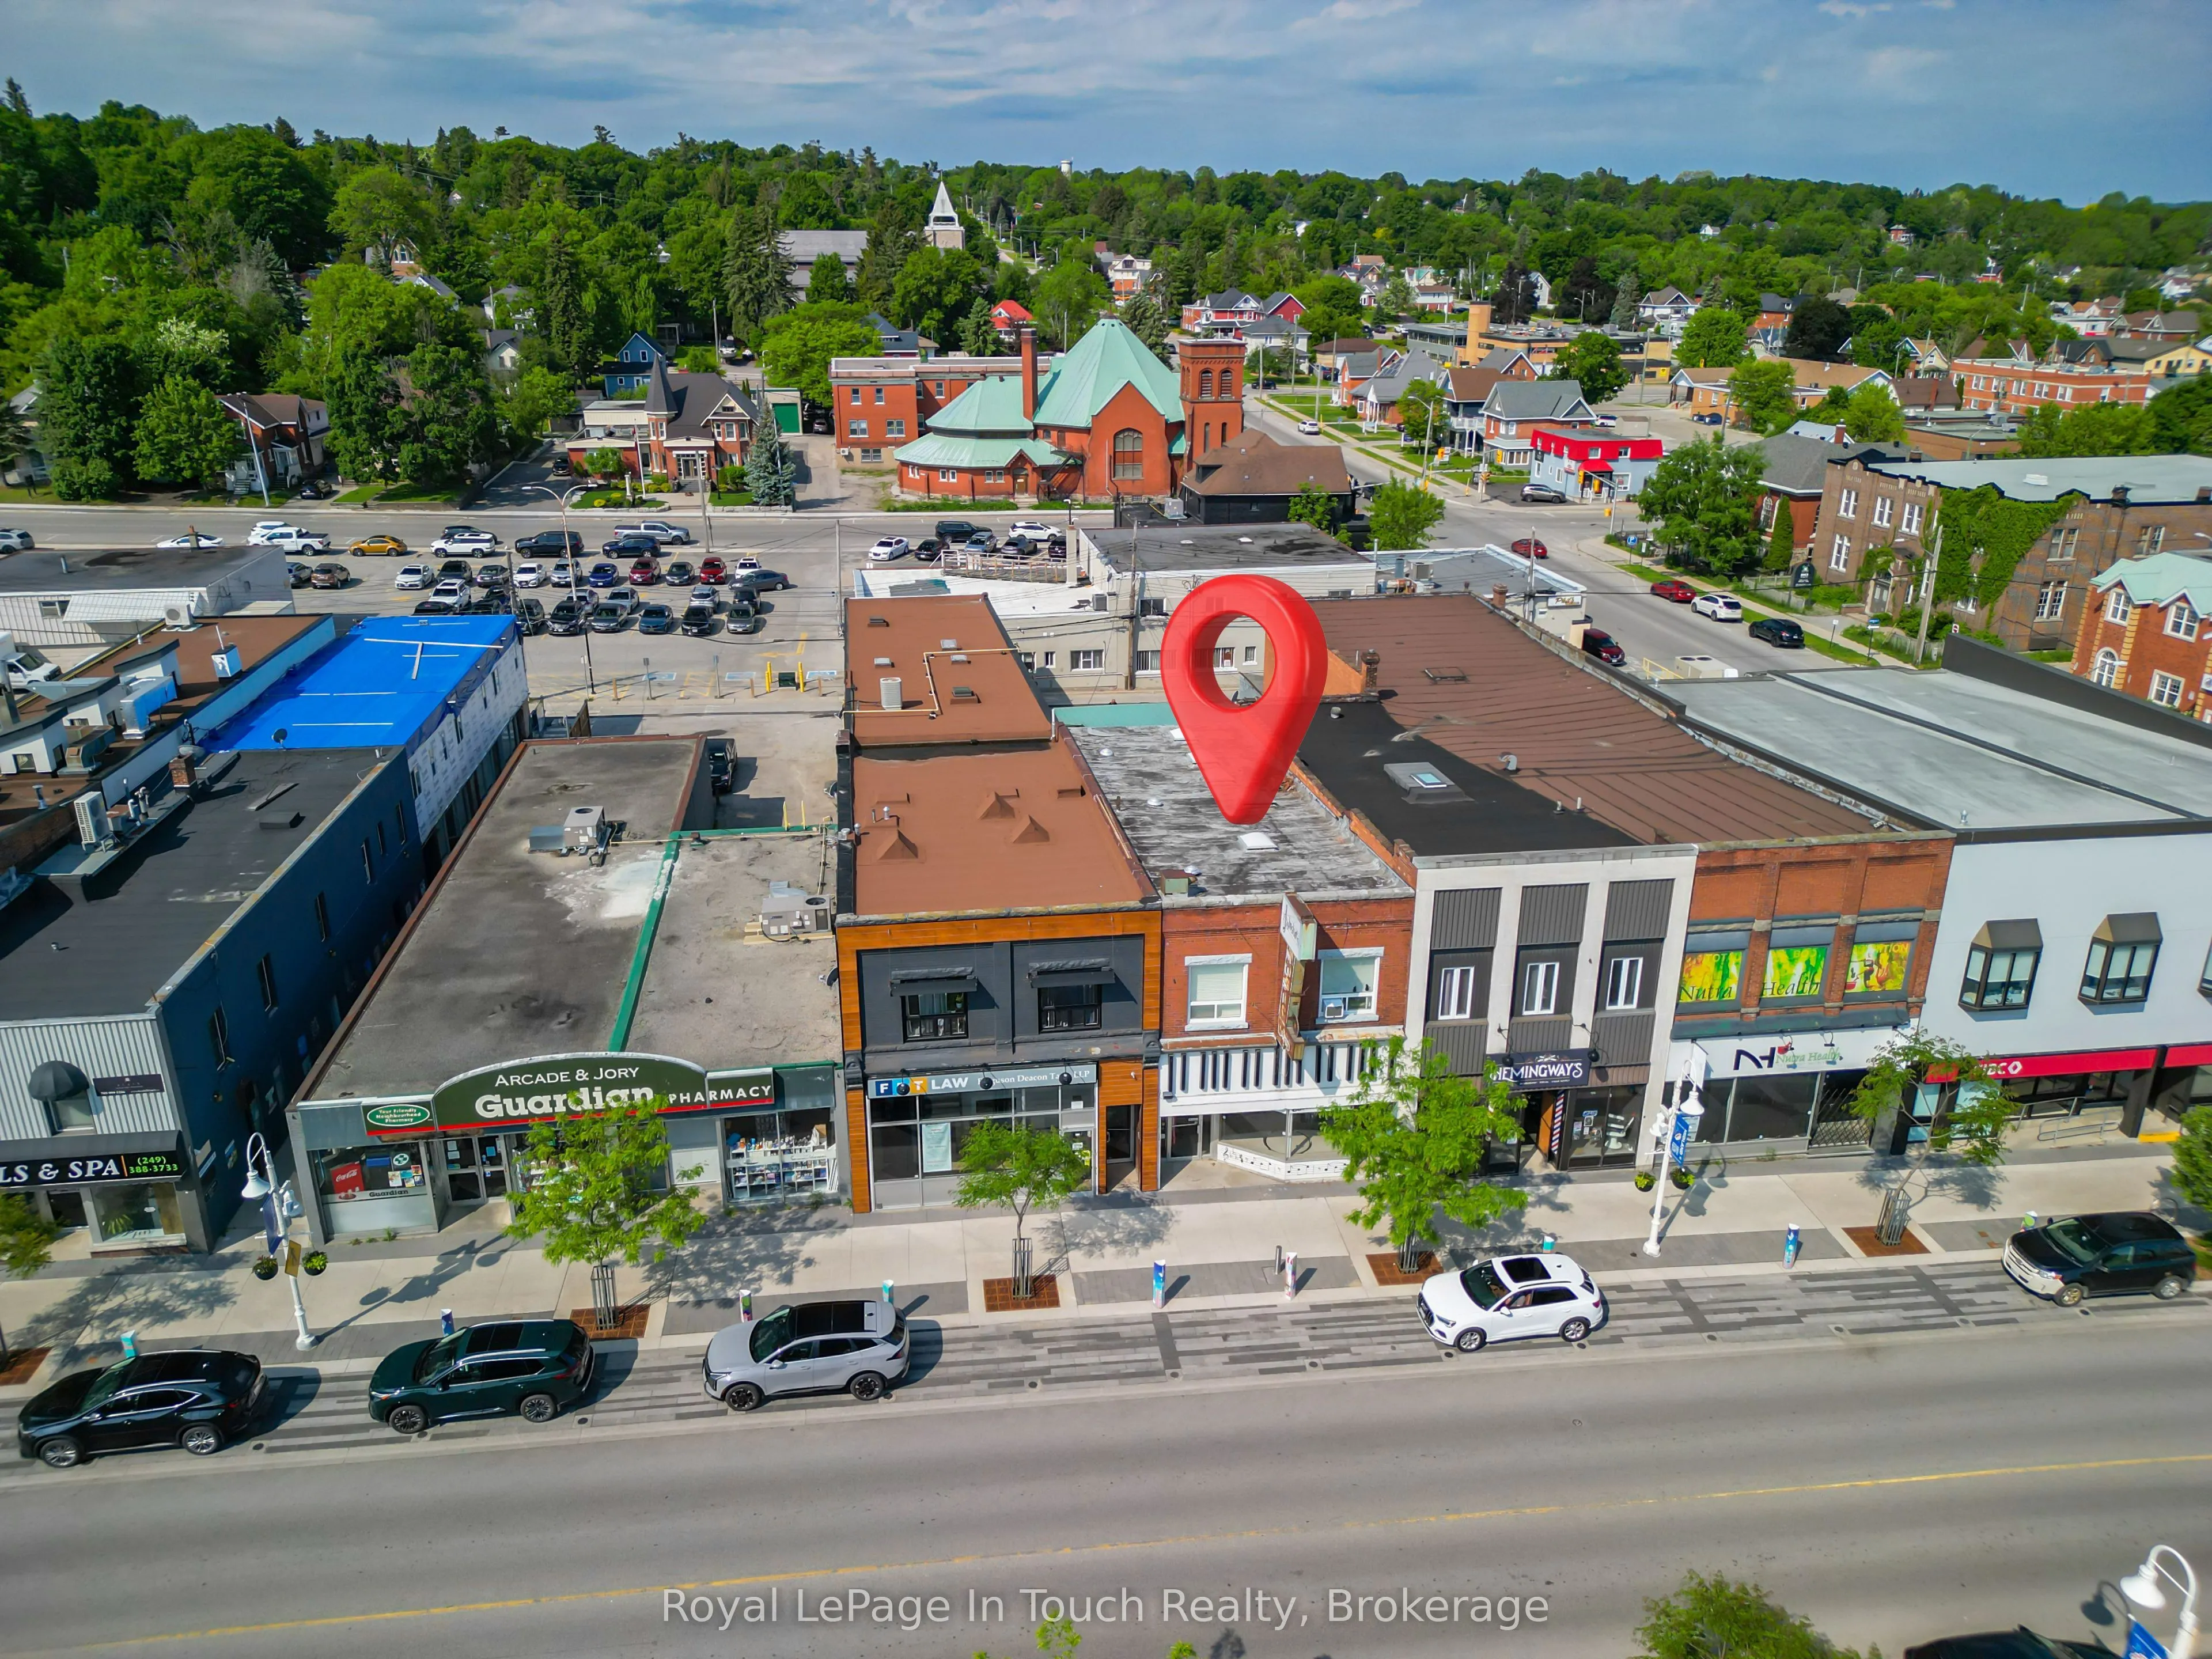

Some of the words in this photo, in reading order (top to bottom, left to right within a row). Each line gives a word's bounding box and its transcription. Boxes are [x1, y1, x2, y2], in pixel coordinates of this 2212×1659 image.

[1680, 985, 1732, 1001] Nutra
[1762, 971, 1820, 996] Health
[1775, 1054, 1806, 1063] Nutra
[1808, 1047, 1840, 1061] Health
[495, 1071, 571, 1087] ARCADE
[575, 1069, 589, 1081] &
[594, 1067, 640, 1081] JORY
[880, 1081, 923, 1094] FT
[931, 1077, 968, 1090] LAW
[978, 1076, 1015, 1086] Fguson
[1017, 1074, 1047, 1082] Deacon
[1074, 1070, 1090, 1079] LLP
[1490, 1062, 1583, 1082] HEMINGWAY'S
[475, 1086, 654, 1118] Guardian
[668, 1085, 771, 1104] PHARMACY
[37, 1163, 59, 1180] &
[68, 1158, 120, 1179] SPA
[137, 1156, 166, 1165] (249)
[369, 1189, 408, 1198] Guardian
